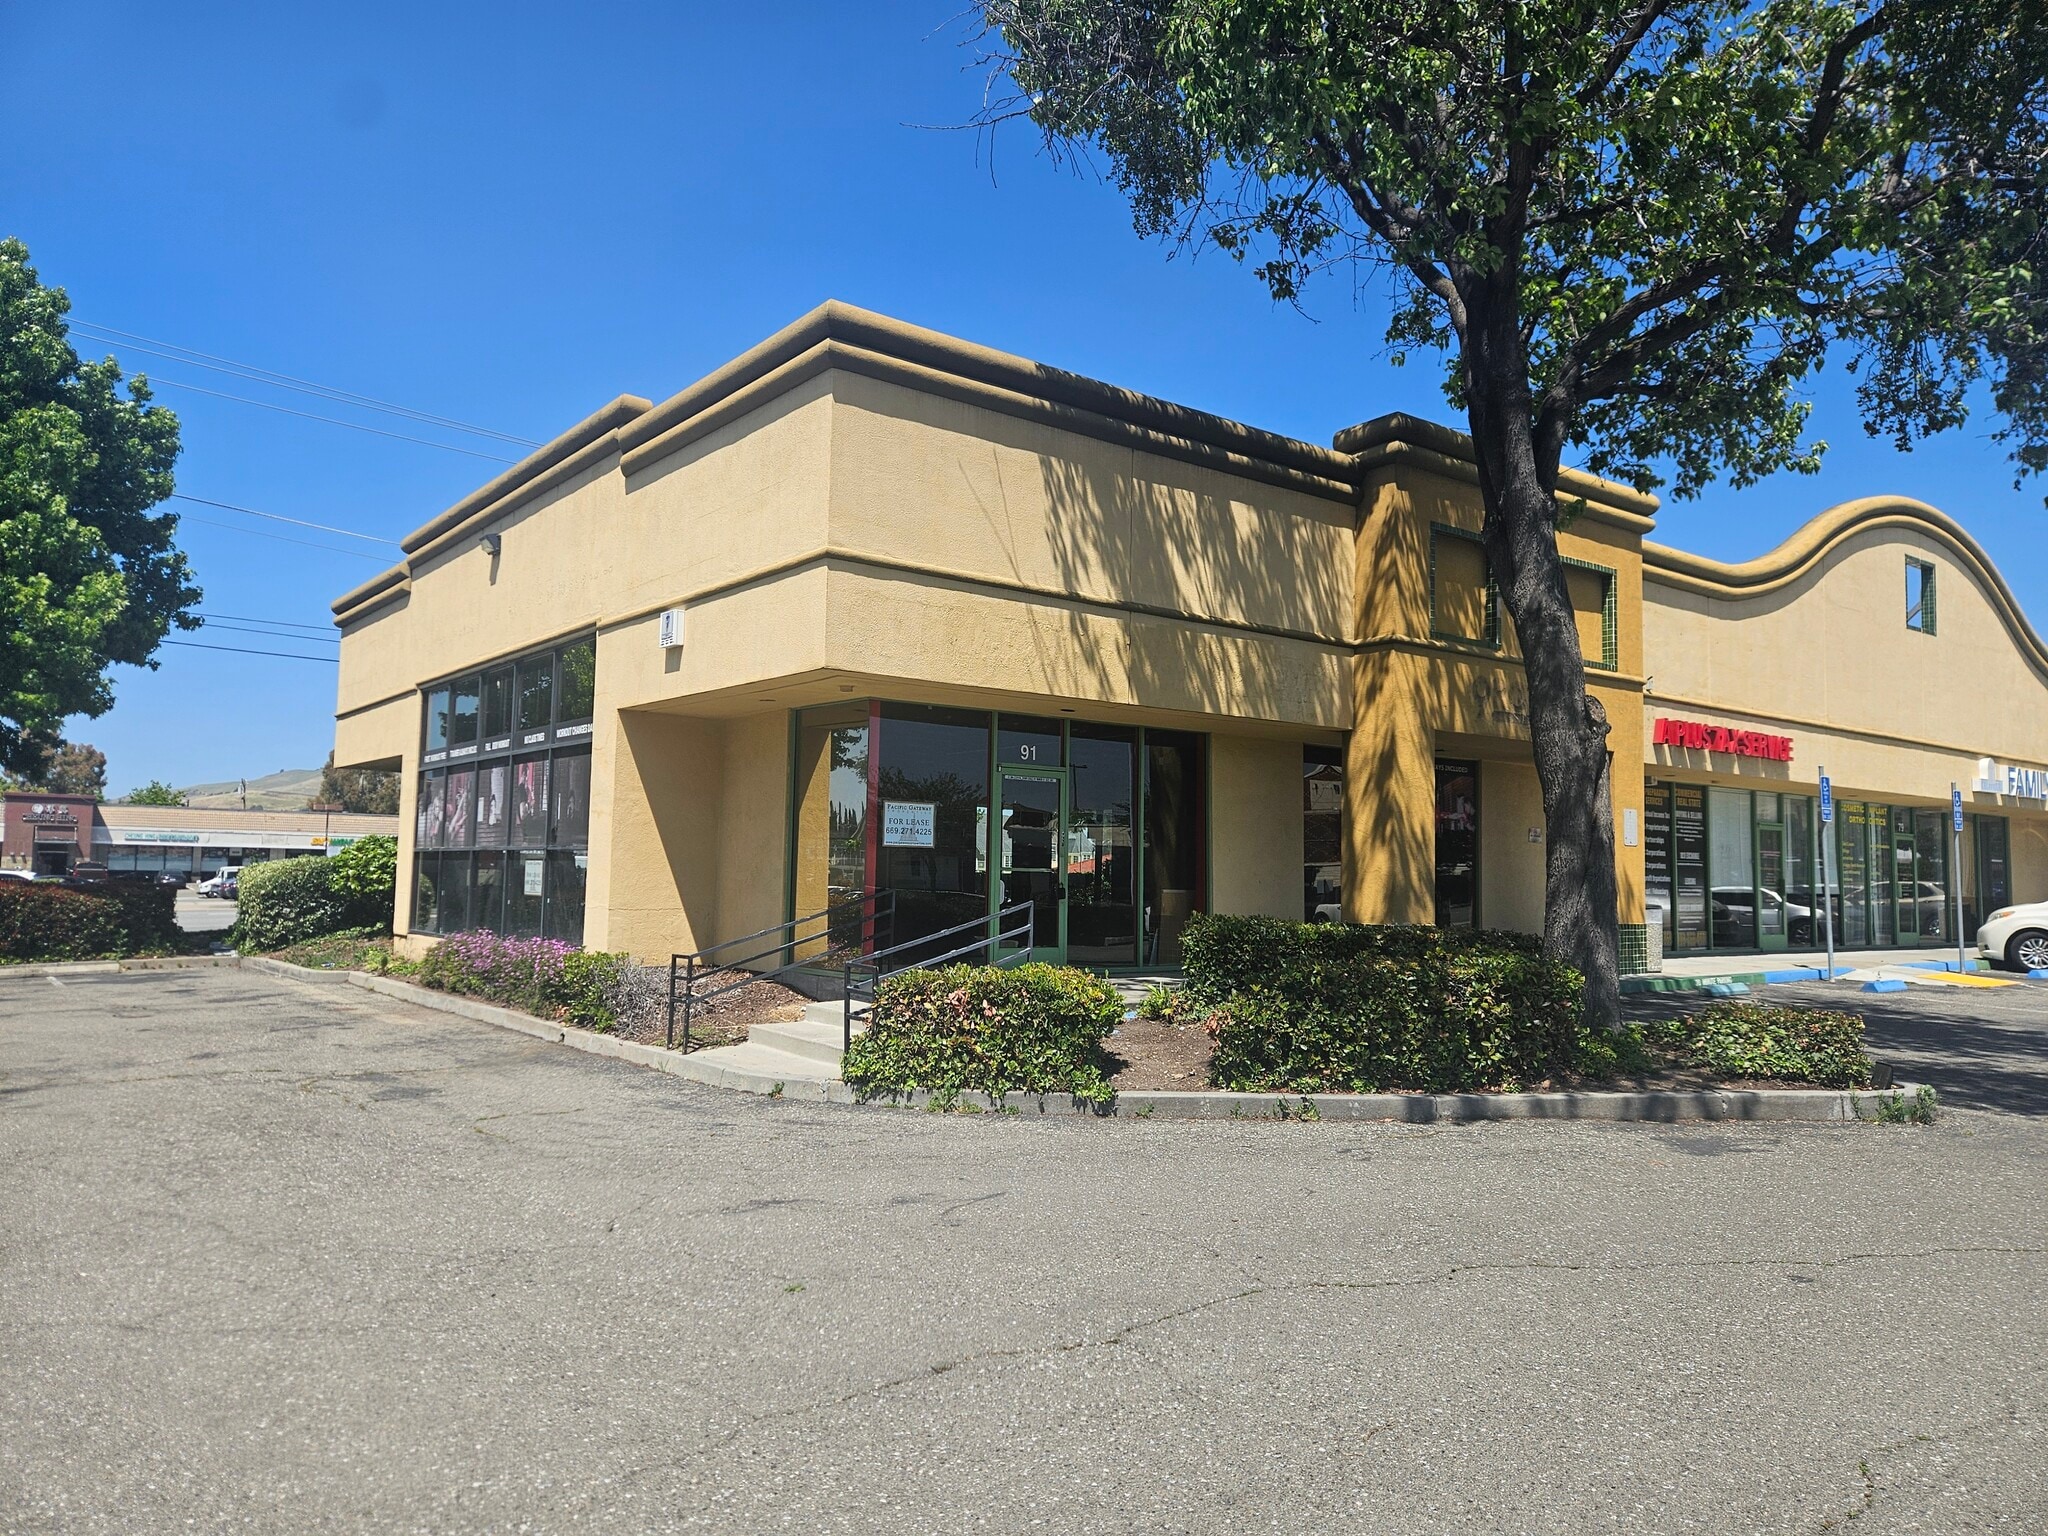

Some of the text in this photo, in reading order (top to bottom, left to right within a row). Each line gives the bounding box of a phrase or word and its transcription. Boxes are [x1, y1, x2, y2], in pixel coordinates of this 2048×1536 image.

[1020, 744, 1036, 761] 91
[1654, 718, 1794, 762] A PLUS TAX SERVICE
[2008, 766, 2048, 800] FAMIL
